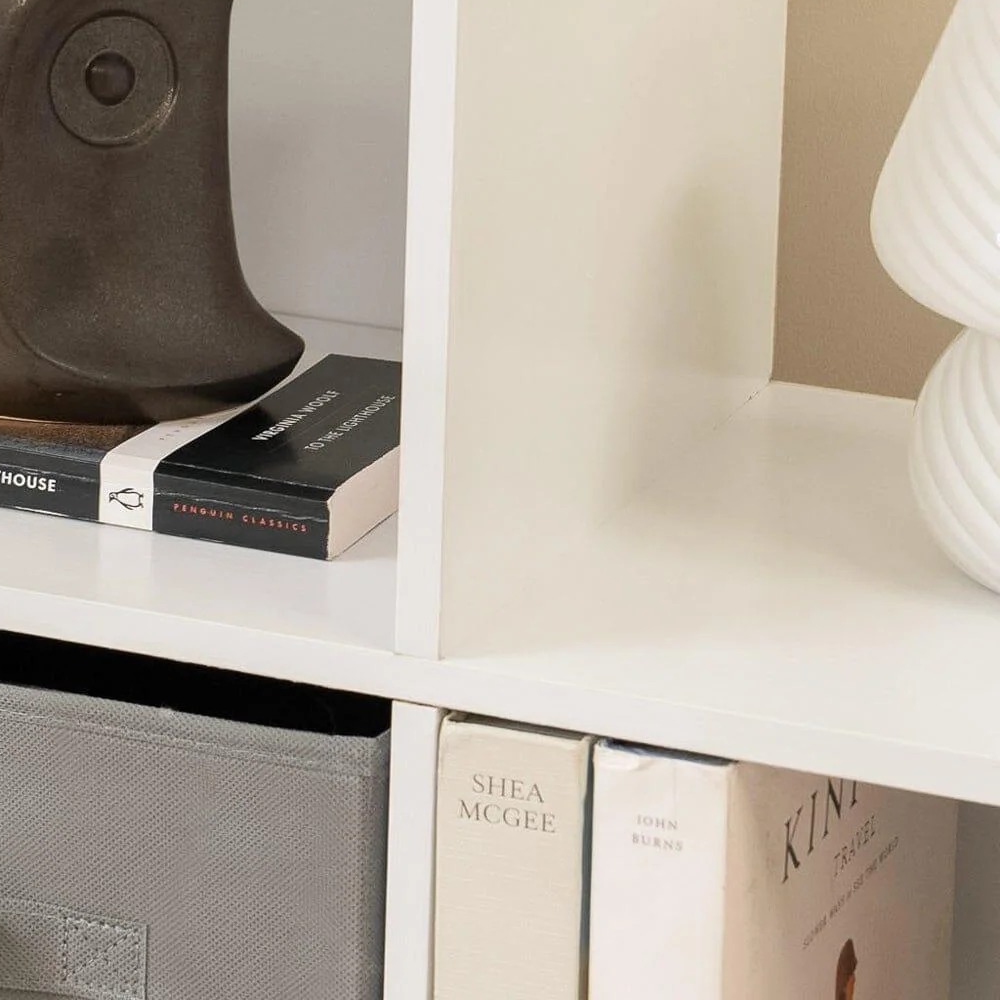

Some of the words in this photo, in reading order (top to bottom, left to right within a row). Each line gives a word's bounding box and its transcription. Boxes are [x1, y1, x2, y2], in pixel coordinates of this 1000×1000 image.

[251, 411, 308, 441] VIRGINIA
[297, 390, 341, 413] WOOLF
[303, 441, 325, 451] TO
[318, 430, 344, 442] THE
[336, 394, 396, 432] LIGHTHOUSE
[172, 502, 234, 520] PENGUIN
[242, 514, 308, 533] CLASSICS
[472, 773, 544, 804] SHEA
[458, 799, 557, 834] MCGEE
[631, 833, 684, 852] BURNS
